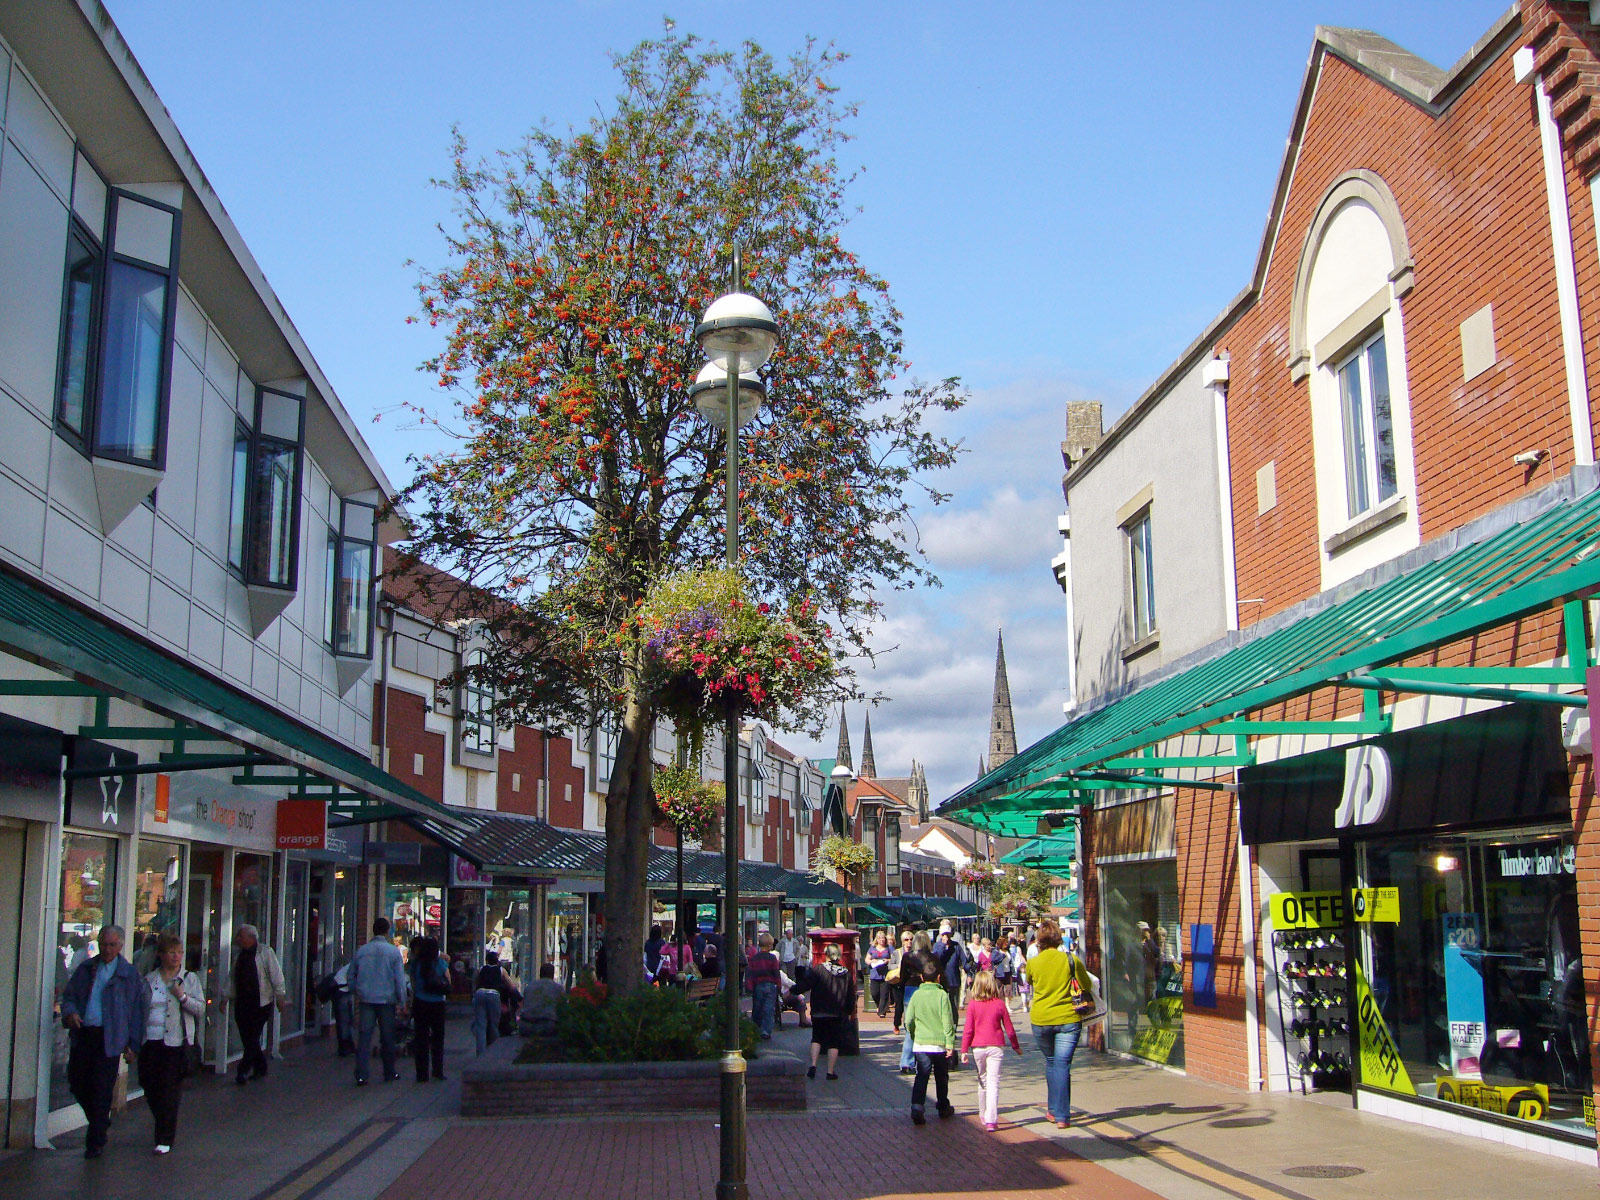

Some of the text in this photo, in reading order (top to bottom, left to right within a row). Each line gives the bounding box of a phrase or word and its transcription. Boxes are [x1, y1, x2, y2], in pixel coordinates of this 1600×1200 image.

[1335, 745, 1392, 829] JD
[196, 797, 254, 834] the Orange shop
[279, 834, 320, 845] orange
[1499, 848, 1562, 876] Timberland
[1448, 928, 1476, 947] £20
[1451, 1022, 1483, 1036] FREE
[1452, 1035, 1483, 1044] WALLET
[1360, 994, 1399, 1087] OFFER
[1516, 1099, 1543, 1121] JD
